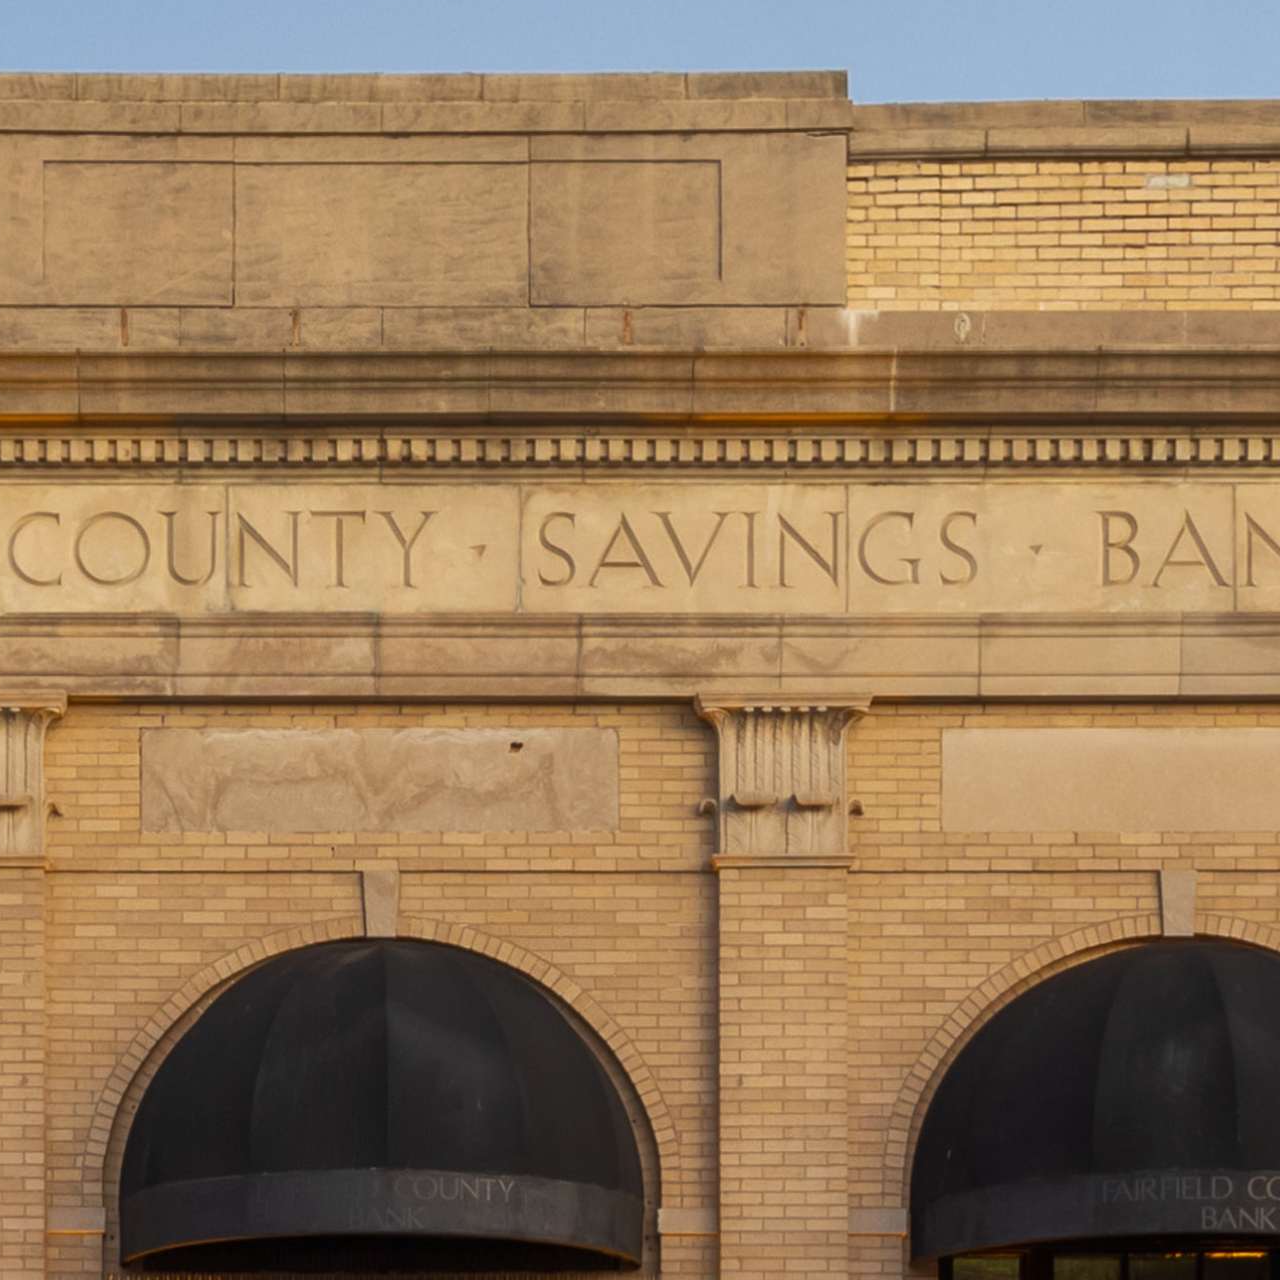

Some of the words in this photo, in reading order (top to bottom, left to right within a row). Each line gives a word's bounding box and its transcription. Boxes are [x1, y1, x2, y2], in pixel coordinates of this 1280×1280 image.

[6, 509, 440, 591] COUNTY
[535, 509, 980, 590] SAVINGS
[393, 1175, 516, 1203] COUNTY
[1101, 1174, 1233, 1203] FAIRFIELD
[1200, 1206, 1278, 1231] BANK
